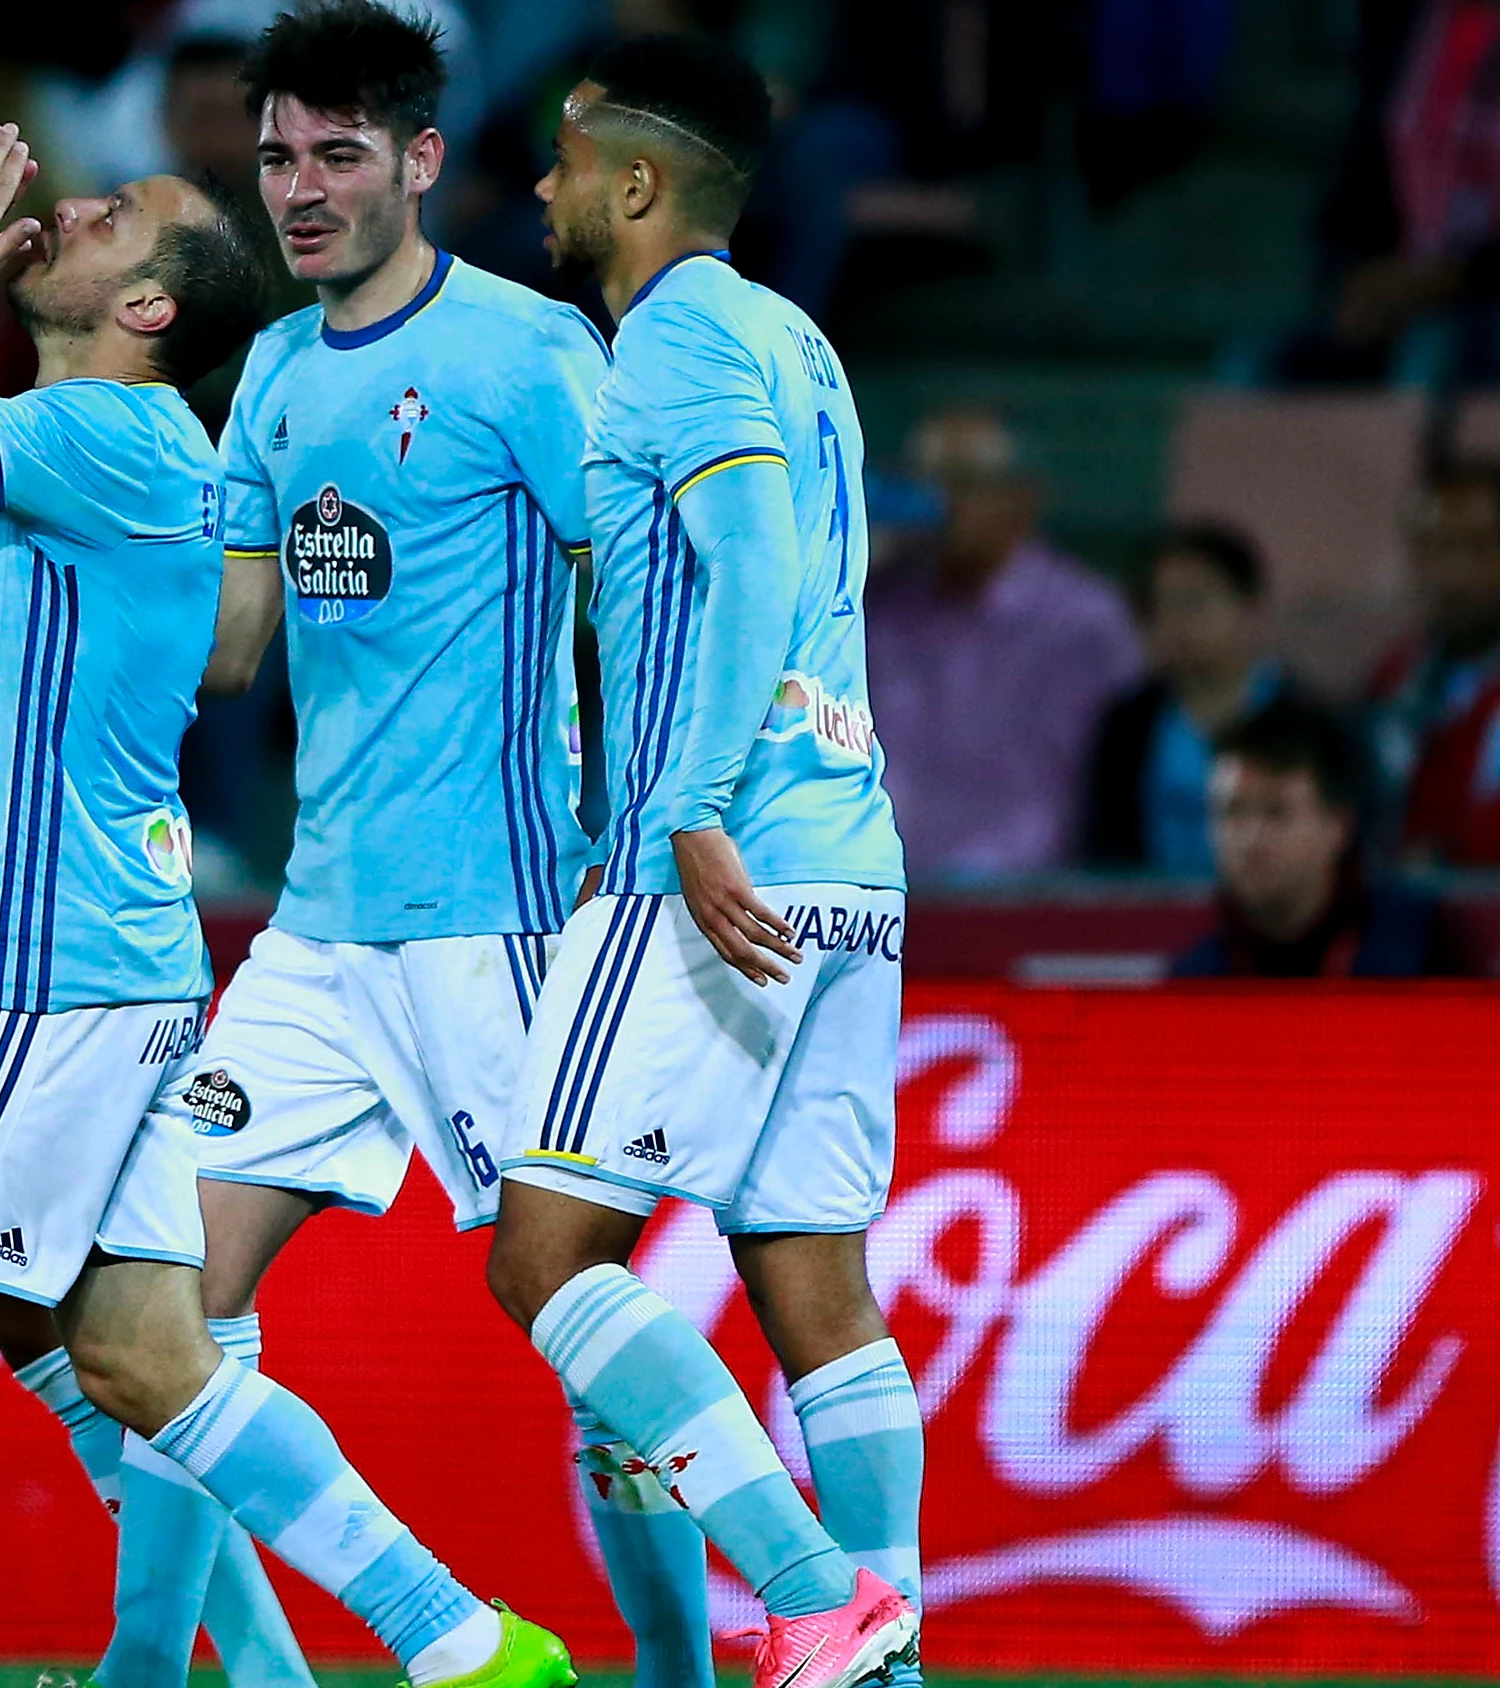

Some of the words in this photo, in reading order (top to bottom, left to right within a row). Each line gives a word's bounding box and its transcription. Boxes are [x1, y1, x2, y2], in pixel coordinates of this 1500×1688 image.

[294, 523, 376, 560] Estrella
[297, 558, 370, 596] Galicia
[189, 1080, 243, 1112] Estrella
[622, 1145, 670, 1166] adidas
